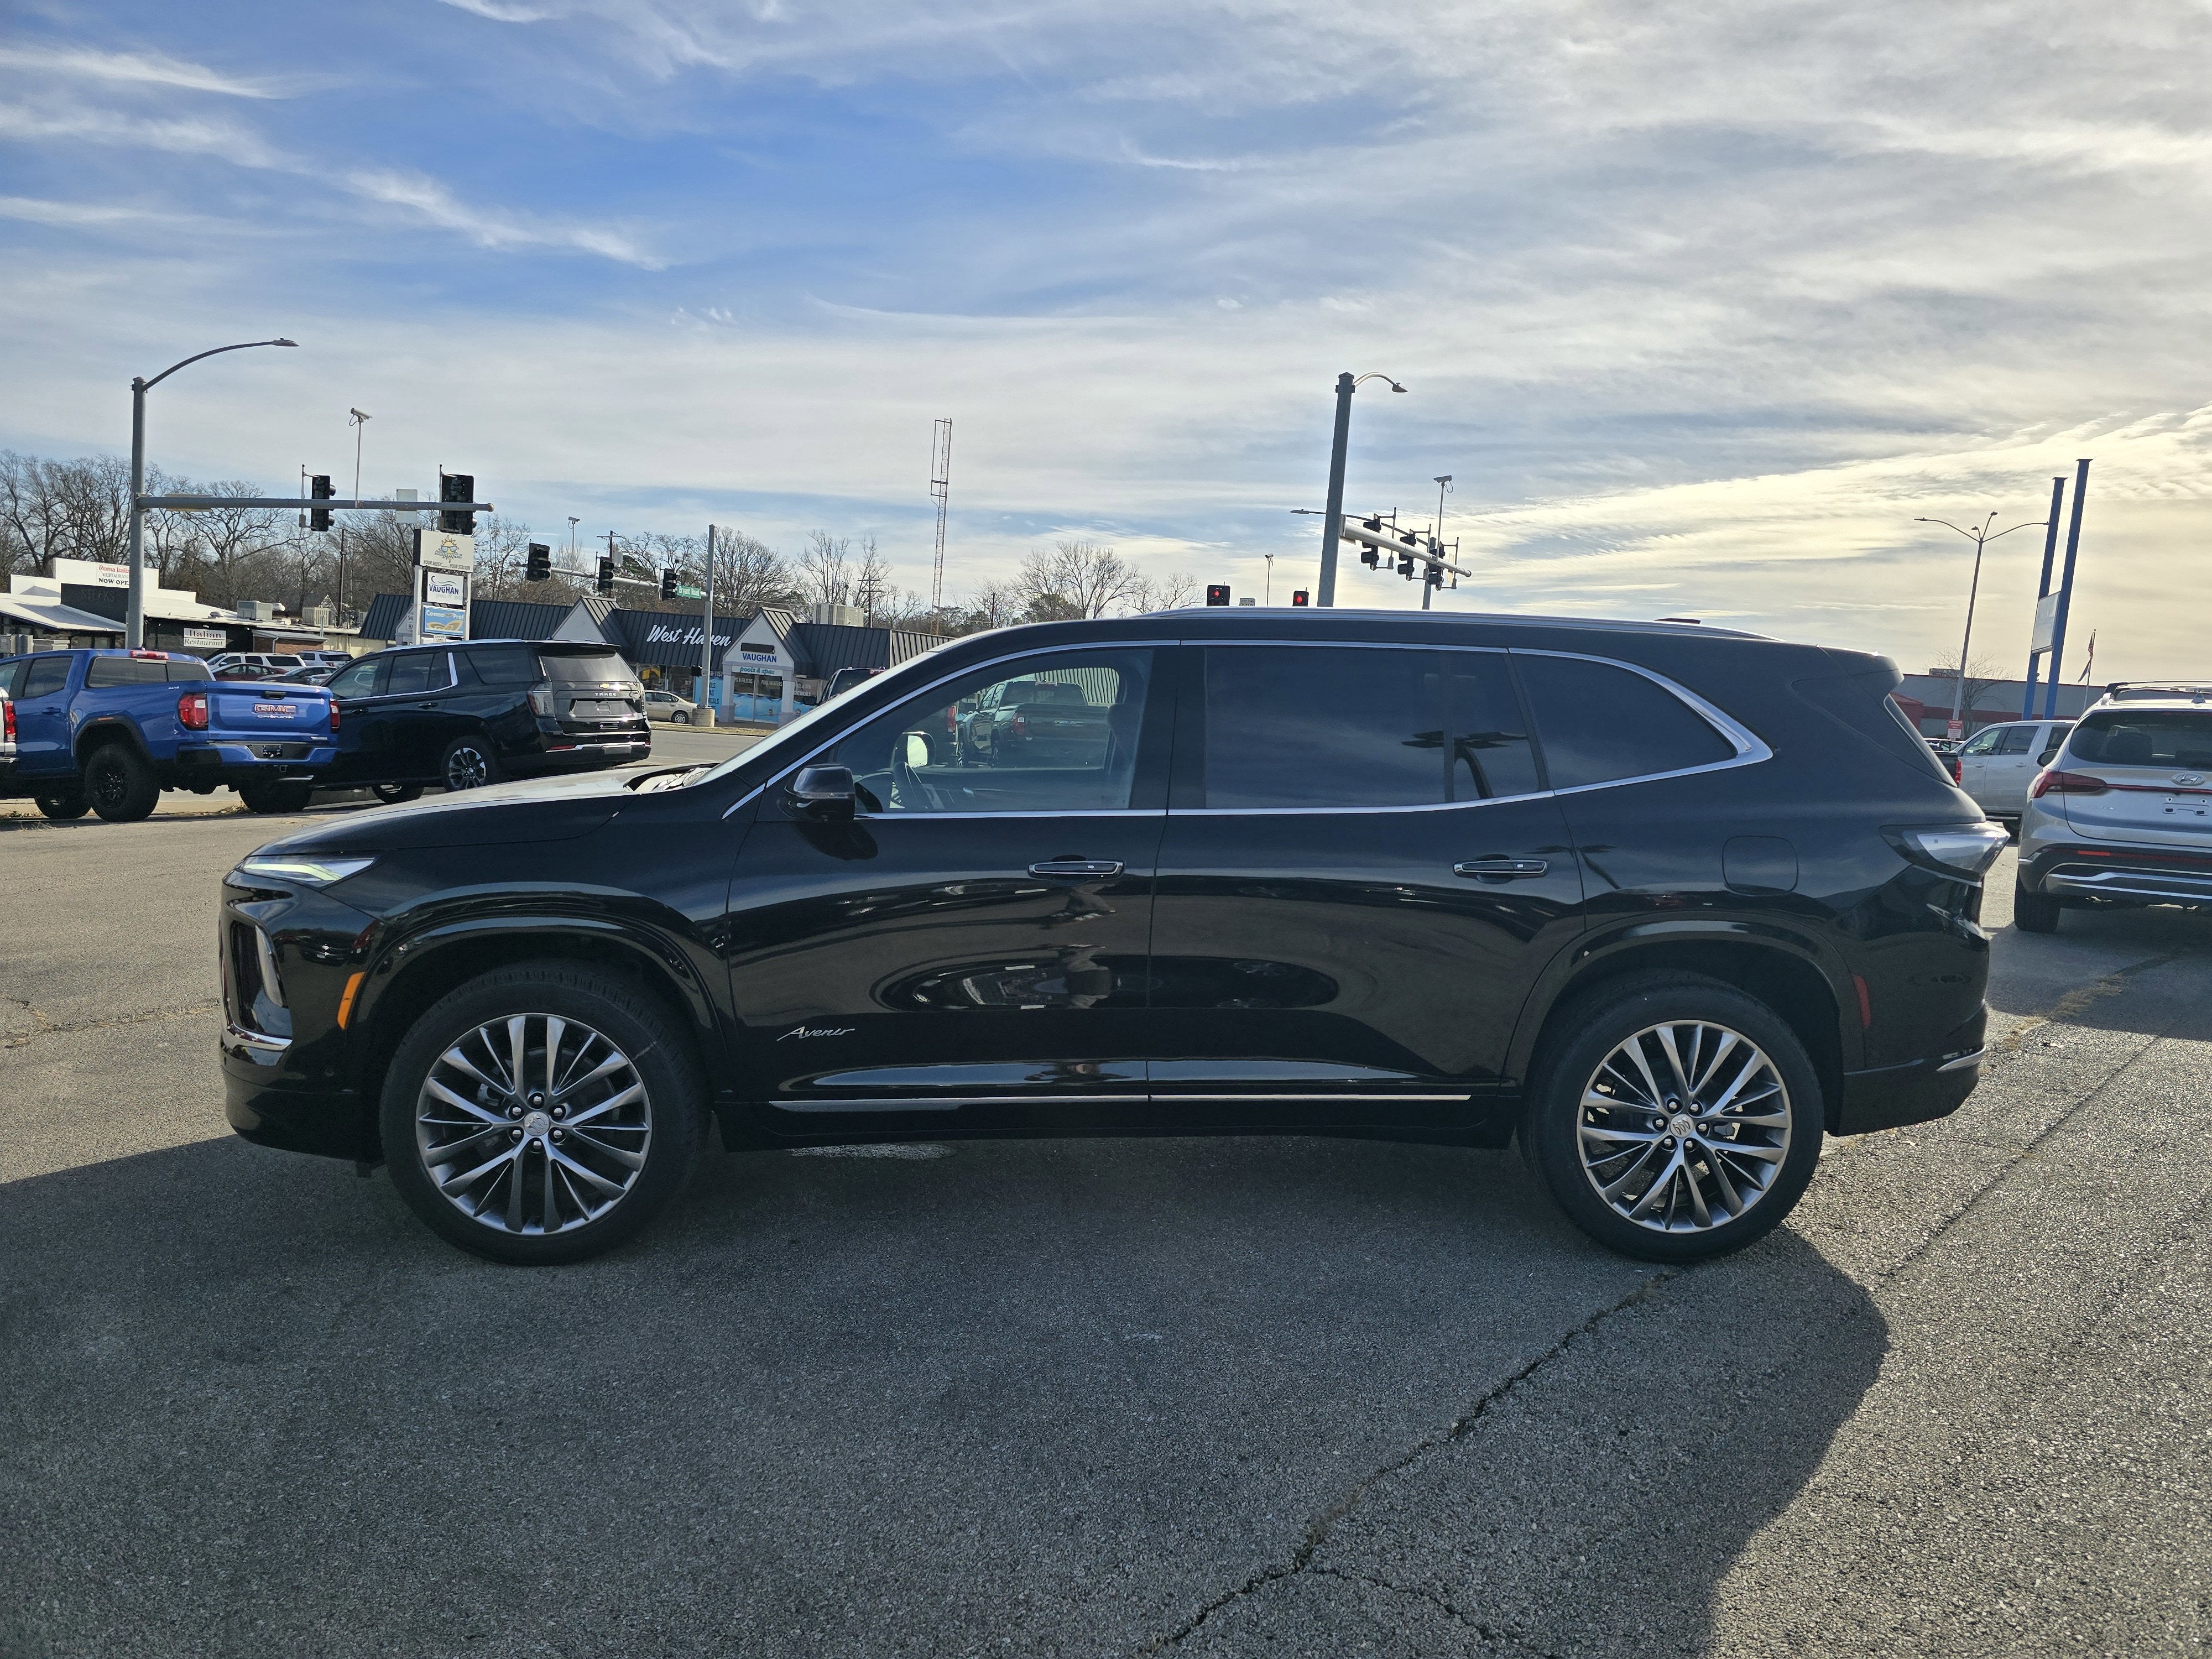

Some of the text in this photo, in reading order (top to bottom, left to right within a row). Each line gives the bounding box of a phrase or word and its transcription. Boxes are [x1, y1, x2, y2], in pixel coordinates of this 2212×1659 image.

[429, 583, 459, 595] VAUGHAN
[189, 630, 221, 639] Italian
[646, 624, 683, 643] West
[184, 638, 223, 646] Restaurant
[742, 653, 777, 663] VAUGHAN
[254, 703, 296, 714] GMC
[776, 1026, 855, 1041] Avenir
